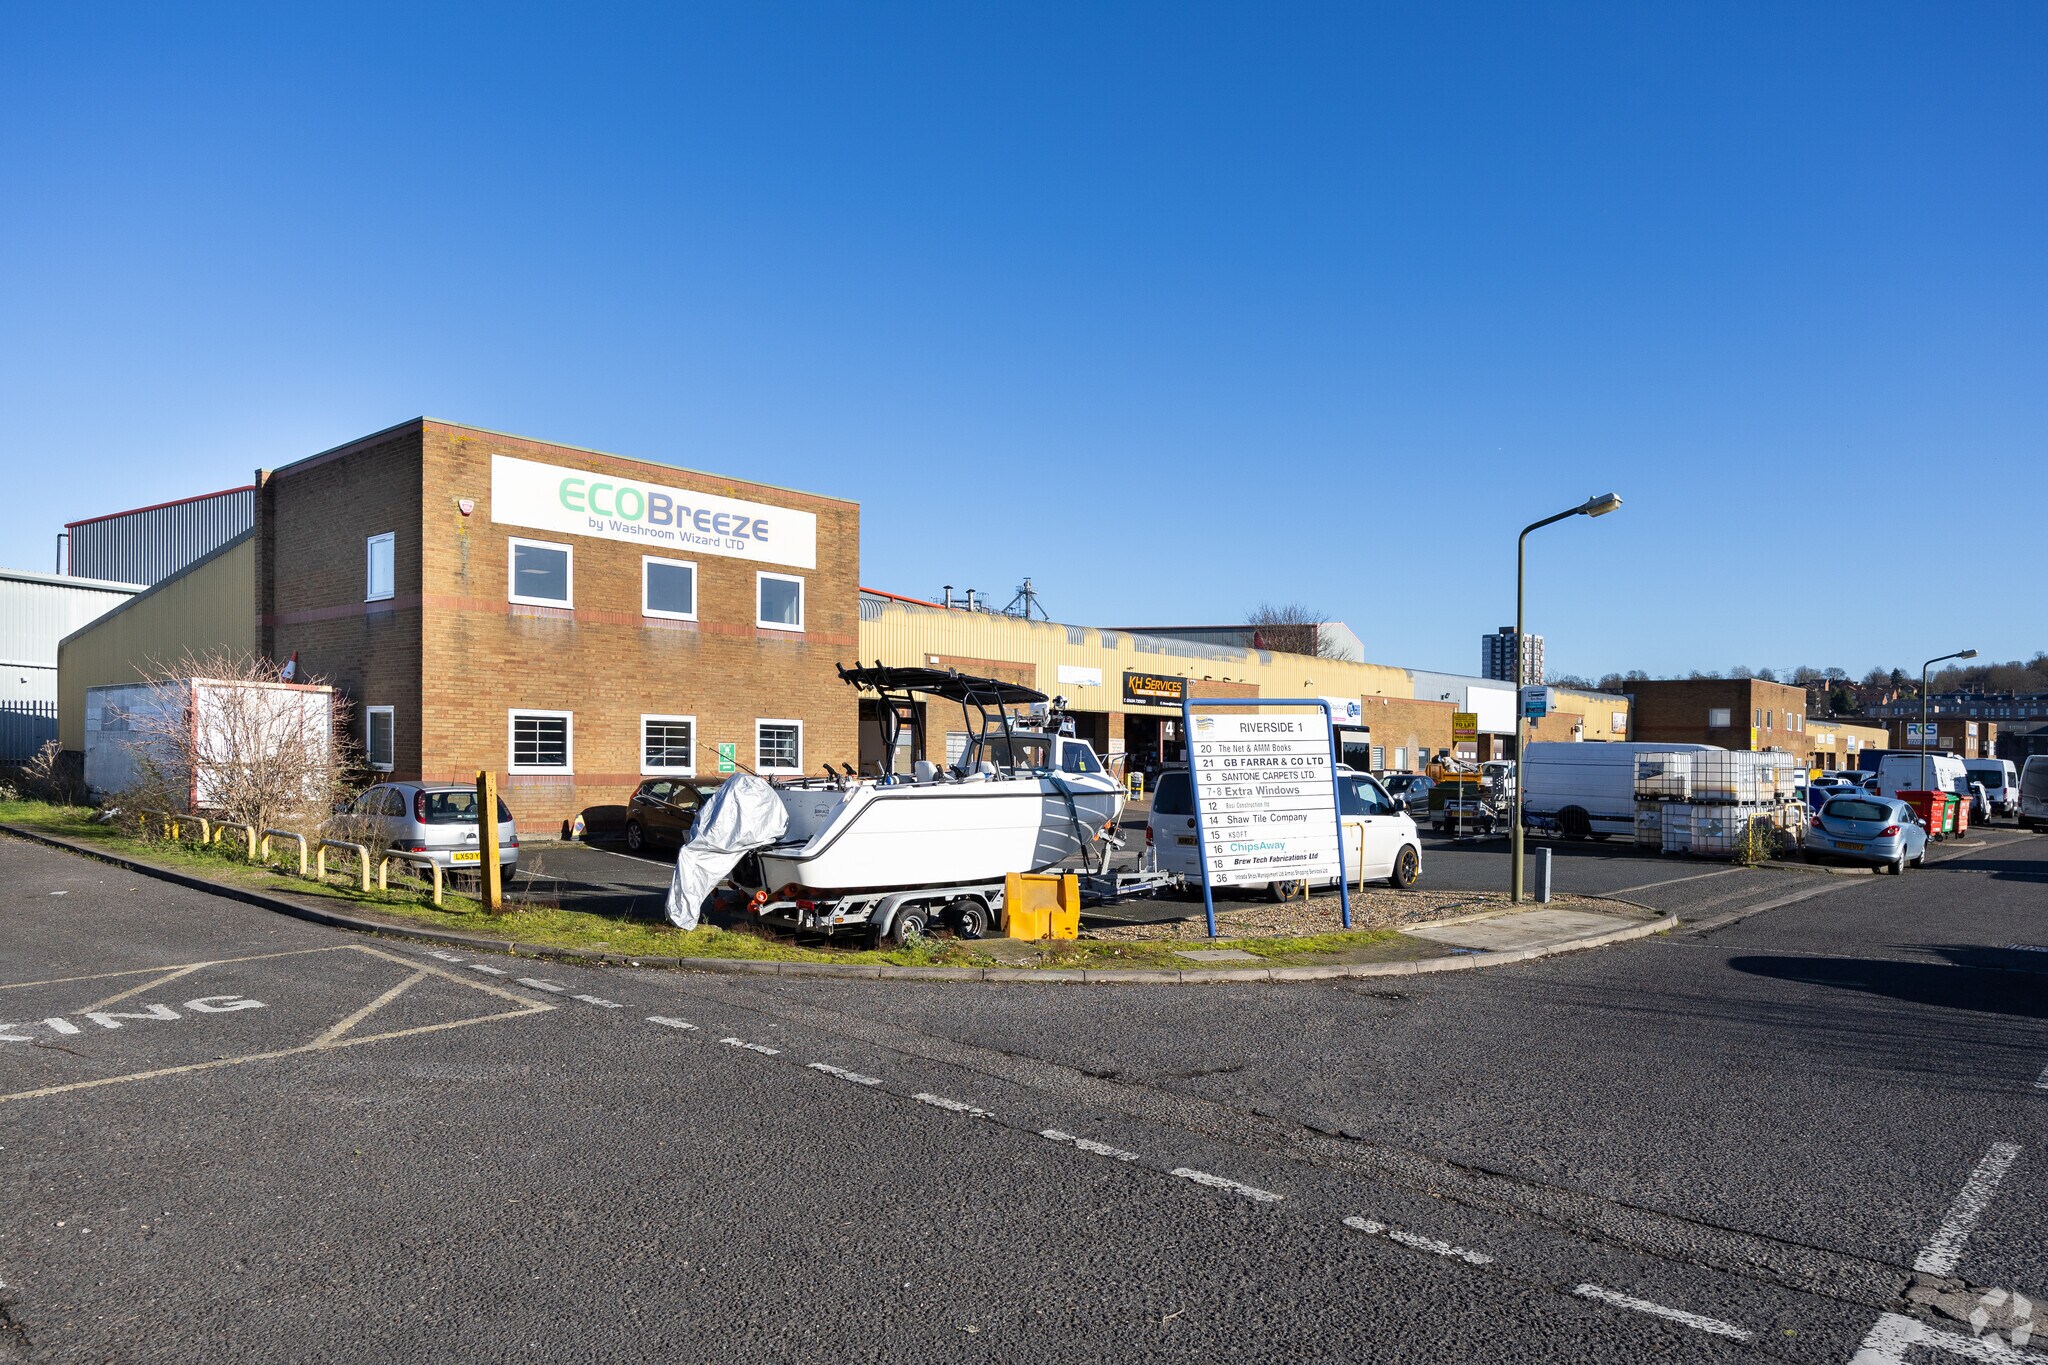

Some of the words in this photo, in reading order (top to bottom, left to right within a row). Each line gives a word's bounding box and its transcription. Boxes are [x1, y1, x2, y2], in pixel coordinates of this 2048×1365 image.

[588, 517, 604, 531] by
[609, 519, 674, 540] Washroom
[680, 531, 721, 547] Wizard
[725, 538, 744, 550] LTD
[1128, 676, 1143, 691] KH
[1145, 677, 1182, 691] SERVICES
[1166, 720, 1173, 736] 4
[1240, 722, 1294, 733] RIVERSIDE
[1298, 722, 1303, 732] 1
[1200, 745, 1212, 753] 20
[1232, 744, 1244, 752] Net
[1247, 744, 1251, 752] &
[1254, 744, 1270, 752] AMM
[1272, 743, 1292, 752] Books
[1203, 759, 1214, 768] 21
[1224, 759, 1237, 767] GB
[1241, 758, 1280, 766] FARRAR
[1281, 758, 1288, 766] &
[1307, 757, 1324, 765] LTD
[1206, 773, 1212, 781] 6
[1222, 772, 1260, 781] SANTONE
[1262, 771, 1298, 780] CARPETS
[1301, 771, 1316, 779] LTD.
[1225, 787, 1253, 796] Extra
[1256, 786, 1300, 795] Windows
[1209, 802, 1217, 810] 12
[1209, 816, 1218, 824] 14
[1227, 815, 1249, 824] Shaw
[1253, 814, 1267, 823] Tile
[1270, 813, 1307, 823] Company
[1211, 831, 1220, 839] 15
[1214, 845, 1223, 853] 16
[1230, 841, 1285, 852] ChipsAway
[1214, 860, 1223, 868] 18
[1253, 856, 1267, 864] Tech
[1269, 854, 1307, 862] Fabrications
[1309, 852, 1318, 860] Ltd
[1216, 874, 1227, 883] 36
